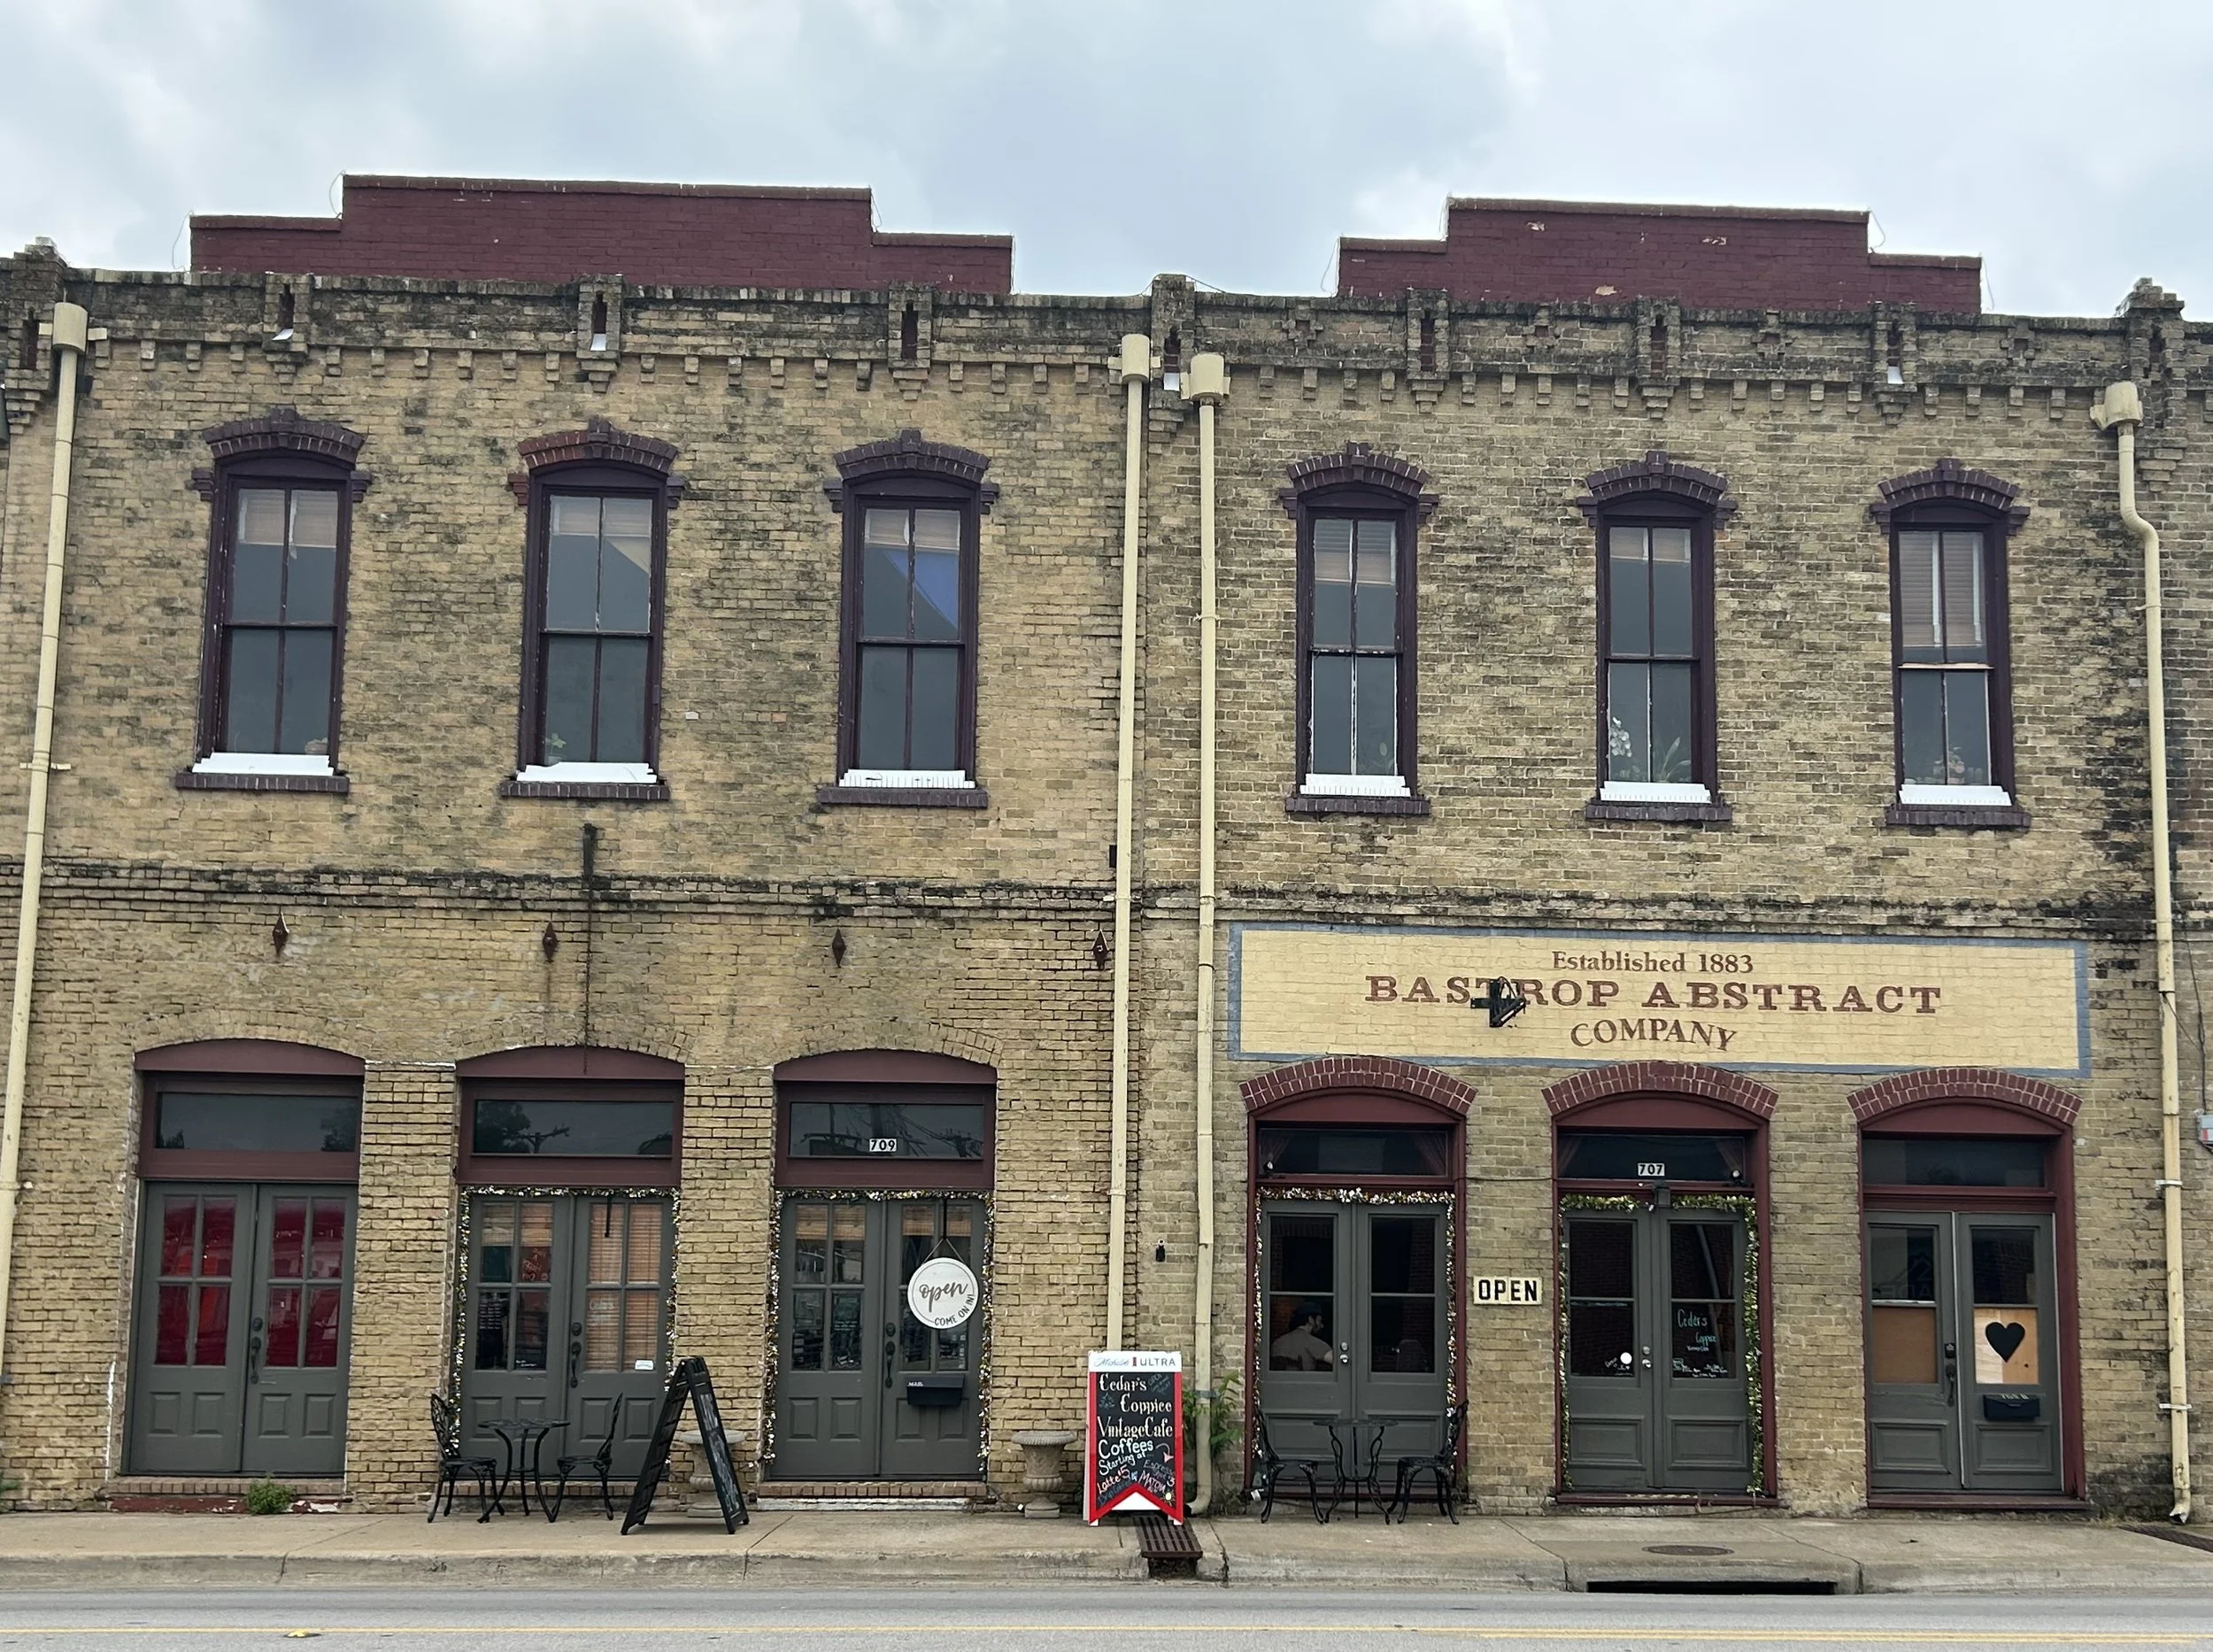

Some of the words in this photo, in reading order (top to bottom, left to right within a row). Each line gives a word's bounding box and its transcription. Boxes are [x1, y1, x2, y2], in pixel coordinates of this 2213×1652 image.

[1552, 950, 1686, 973] Established
[1699, 953, 1754, 974] 1883
[1641, 981, 1941, 1014] ABSTRACT
[1570, 1018, 1738, 1052] COMPANY
[871, 1139, 896, 1151] 709
[1639, 1163, 1663, 1176] 707
[919, 1282, 968, 1313] open
[1478, 1278, 1538, 1301] OPEN
[934, 1314, 958, 1326] COME
[958, 1305, 970, 1318] ON
[1139, 1357, 1176, 1367] ULTRA
[1099, 1438, 1154, 1460] Coffees
[1098, 1453, 1136, 1476] Starting
